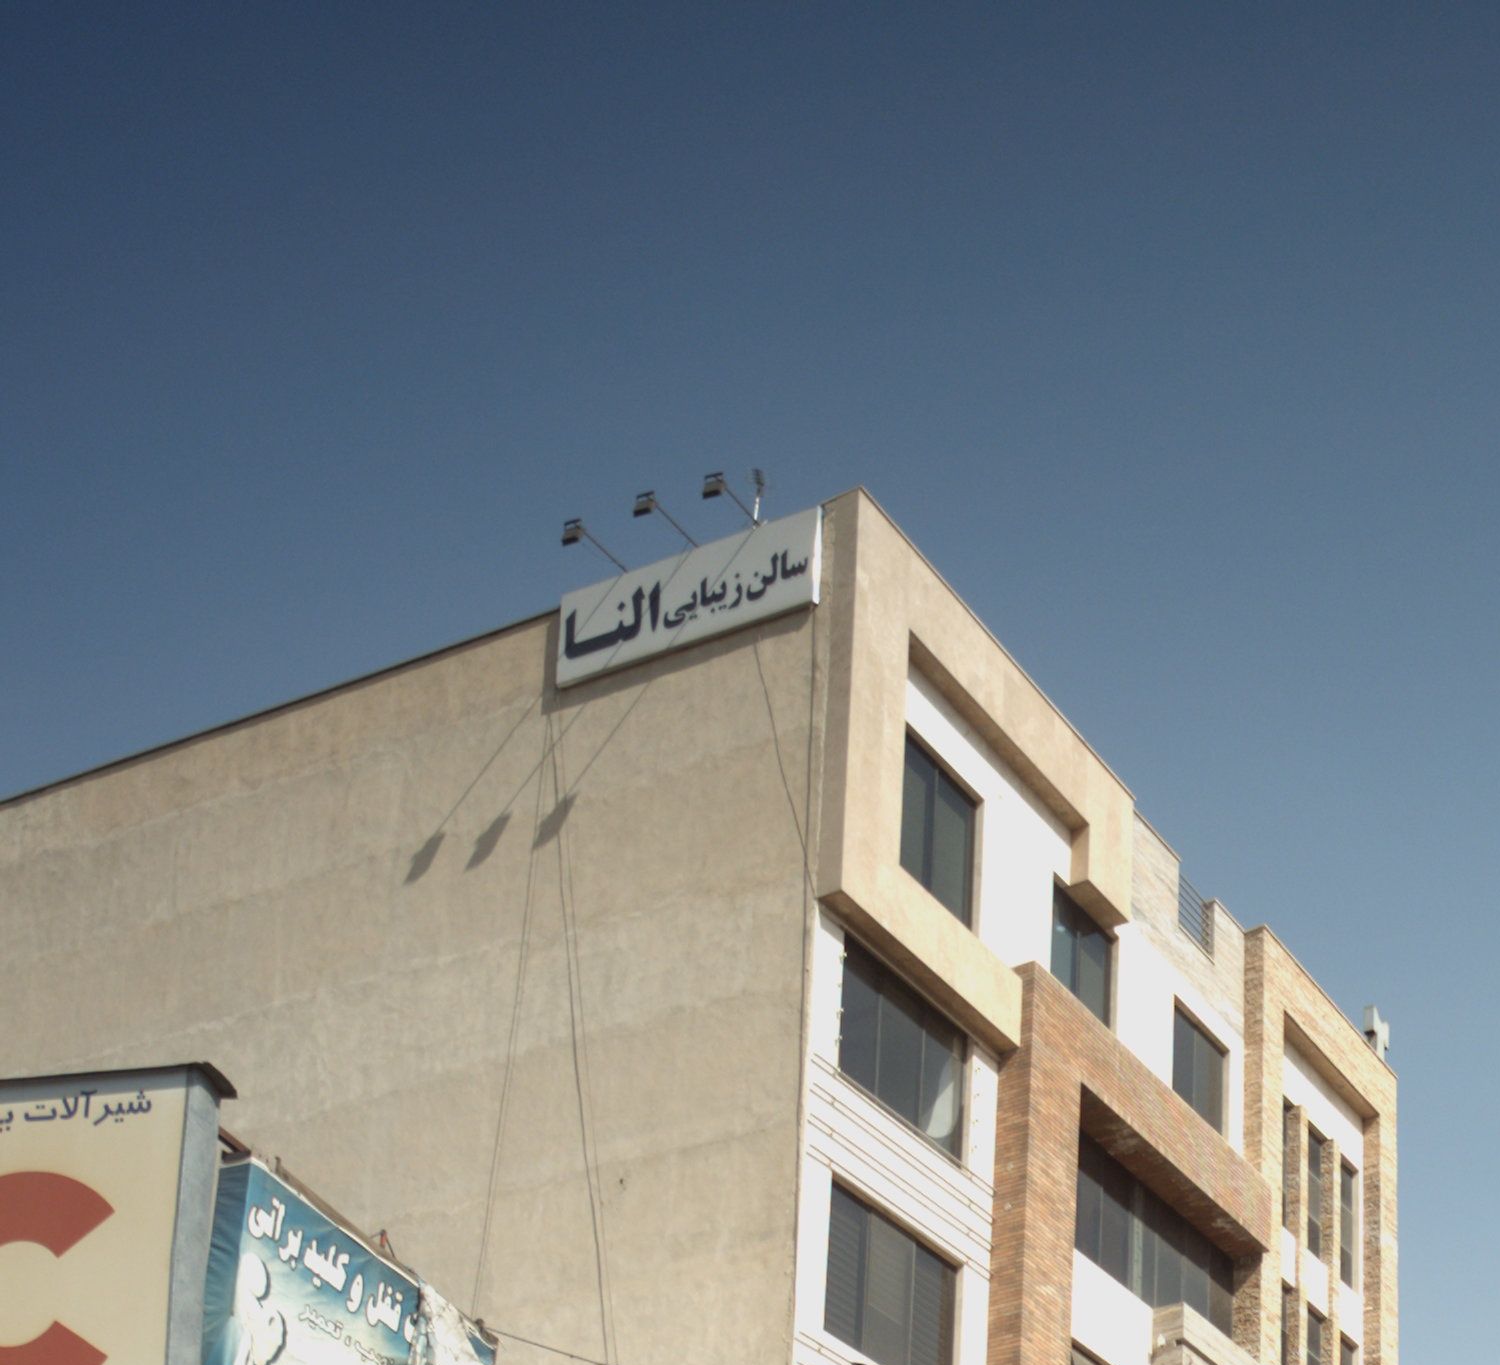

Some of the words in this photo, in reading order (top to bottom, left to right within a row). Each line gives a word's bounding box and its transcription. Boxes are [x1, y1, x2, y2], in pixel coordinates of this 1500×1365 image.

[664, 574, 741, 629] زیبایی
[746, 550, 808, 601] سالن
[565, 581, 660, 660] النا
[303, 1239, 349, 1292] کلید
[346, 1273, 363, 1313] و
[367, 1281, 402, 1332] قفل
